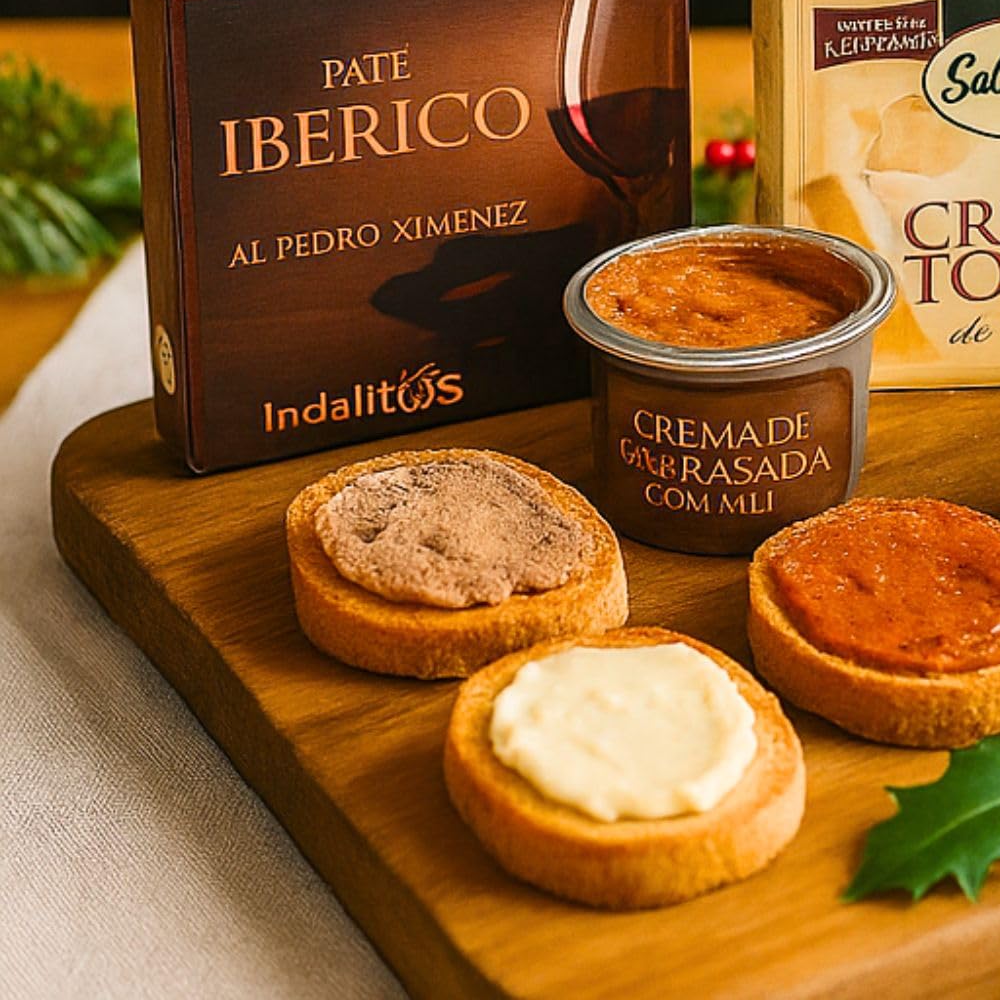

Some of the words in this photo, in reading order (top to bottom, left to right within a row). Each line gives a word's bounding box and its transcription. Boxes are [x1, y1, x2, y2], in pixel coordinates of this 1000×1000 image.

[219, 86, 531, 177] IBERICO
[227, 240, 267, 269] AL
[276, 223, 381, 261] PEDRO
[392, 200, 528, 243] XIMENEZ
[949, 316, 993, 345] de
[645, 482, 710, 514] COM
